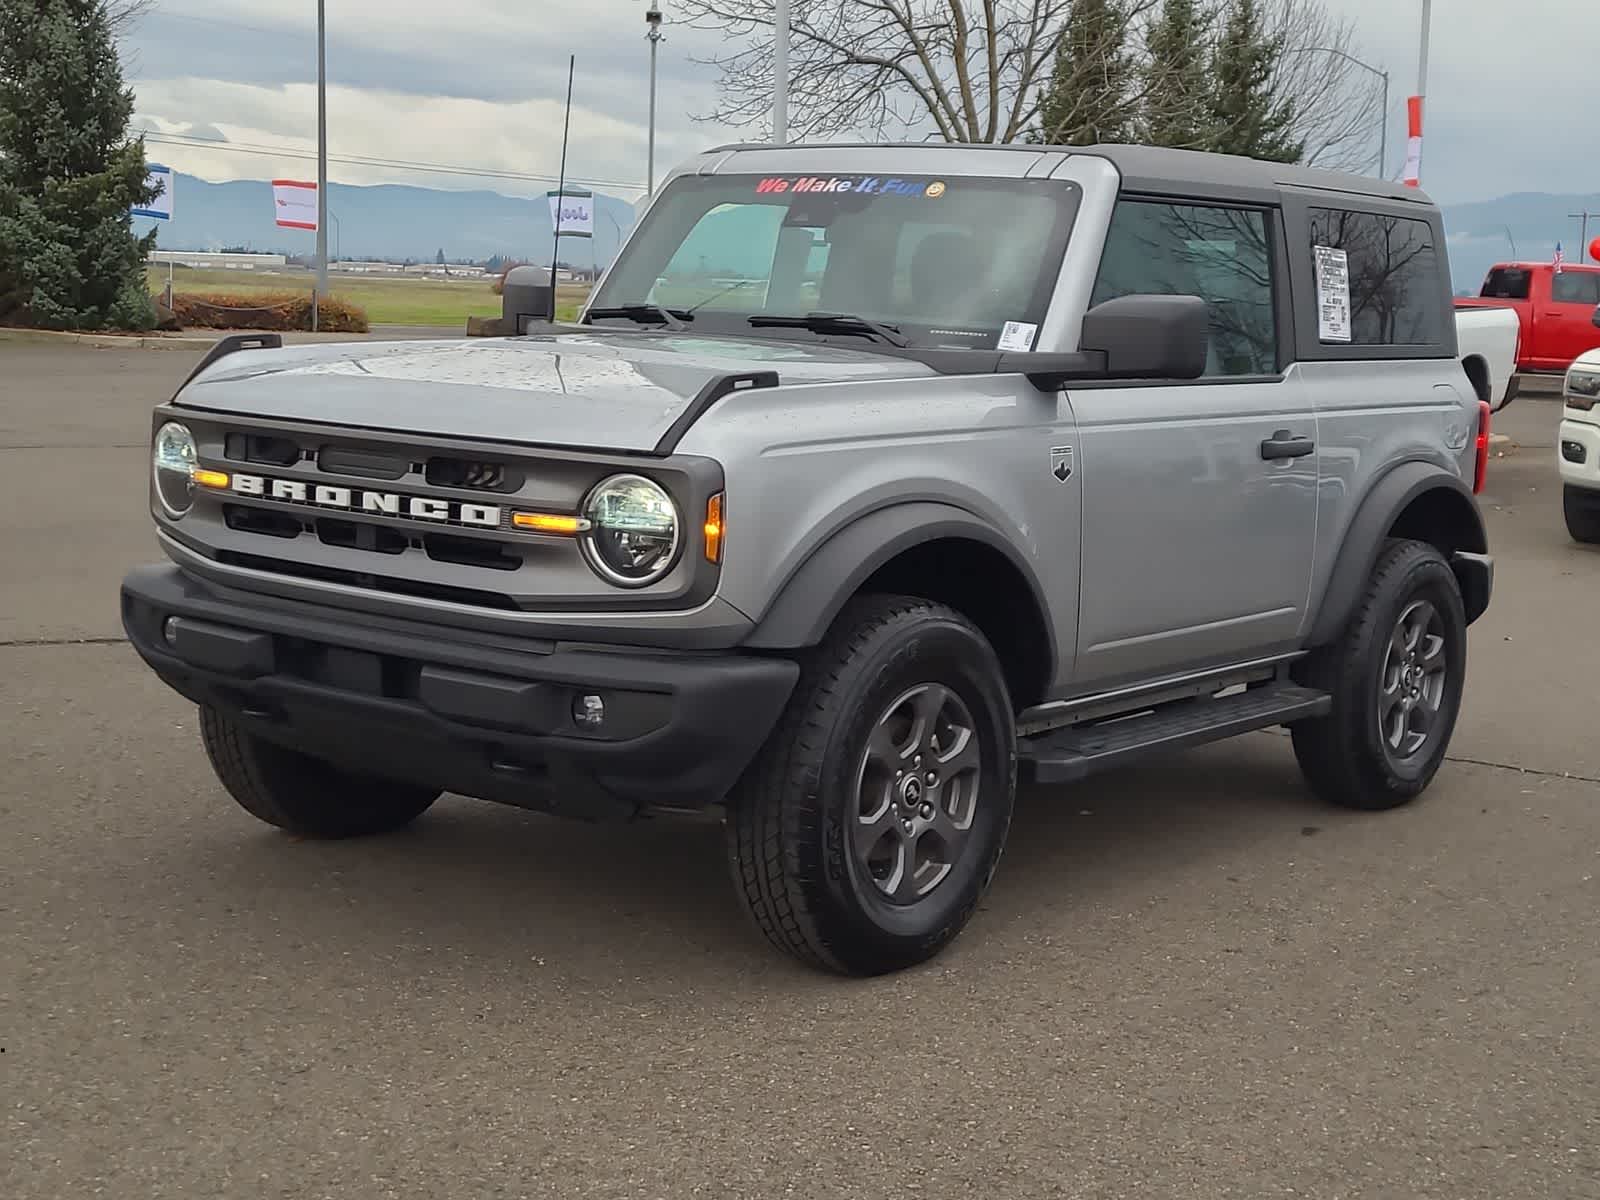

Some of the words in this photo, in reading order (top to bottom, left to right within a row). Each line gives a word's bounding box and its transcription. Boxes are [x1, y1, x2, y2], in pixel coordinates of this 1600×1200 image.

[756, 178, 789, 193] We
[791, 177, 852, 193] Make
[855, 177, 879, 193] It
[880, 179, 925, 197] Fun
[231, 473, 501, 526] BRONCO
